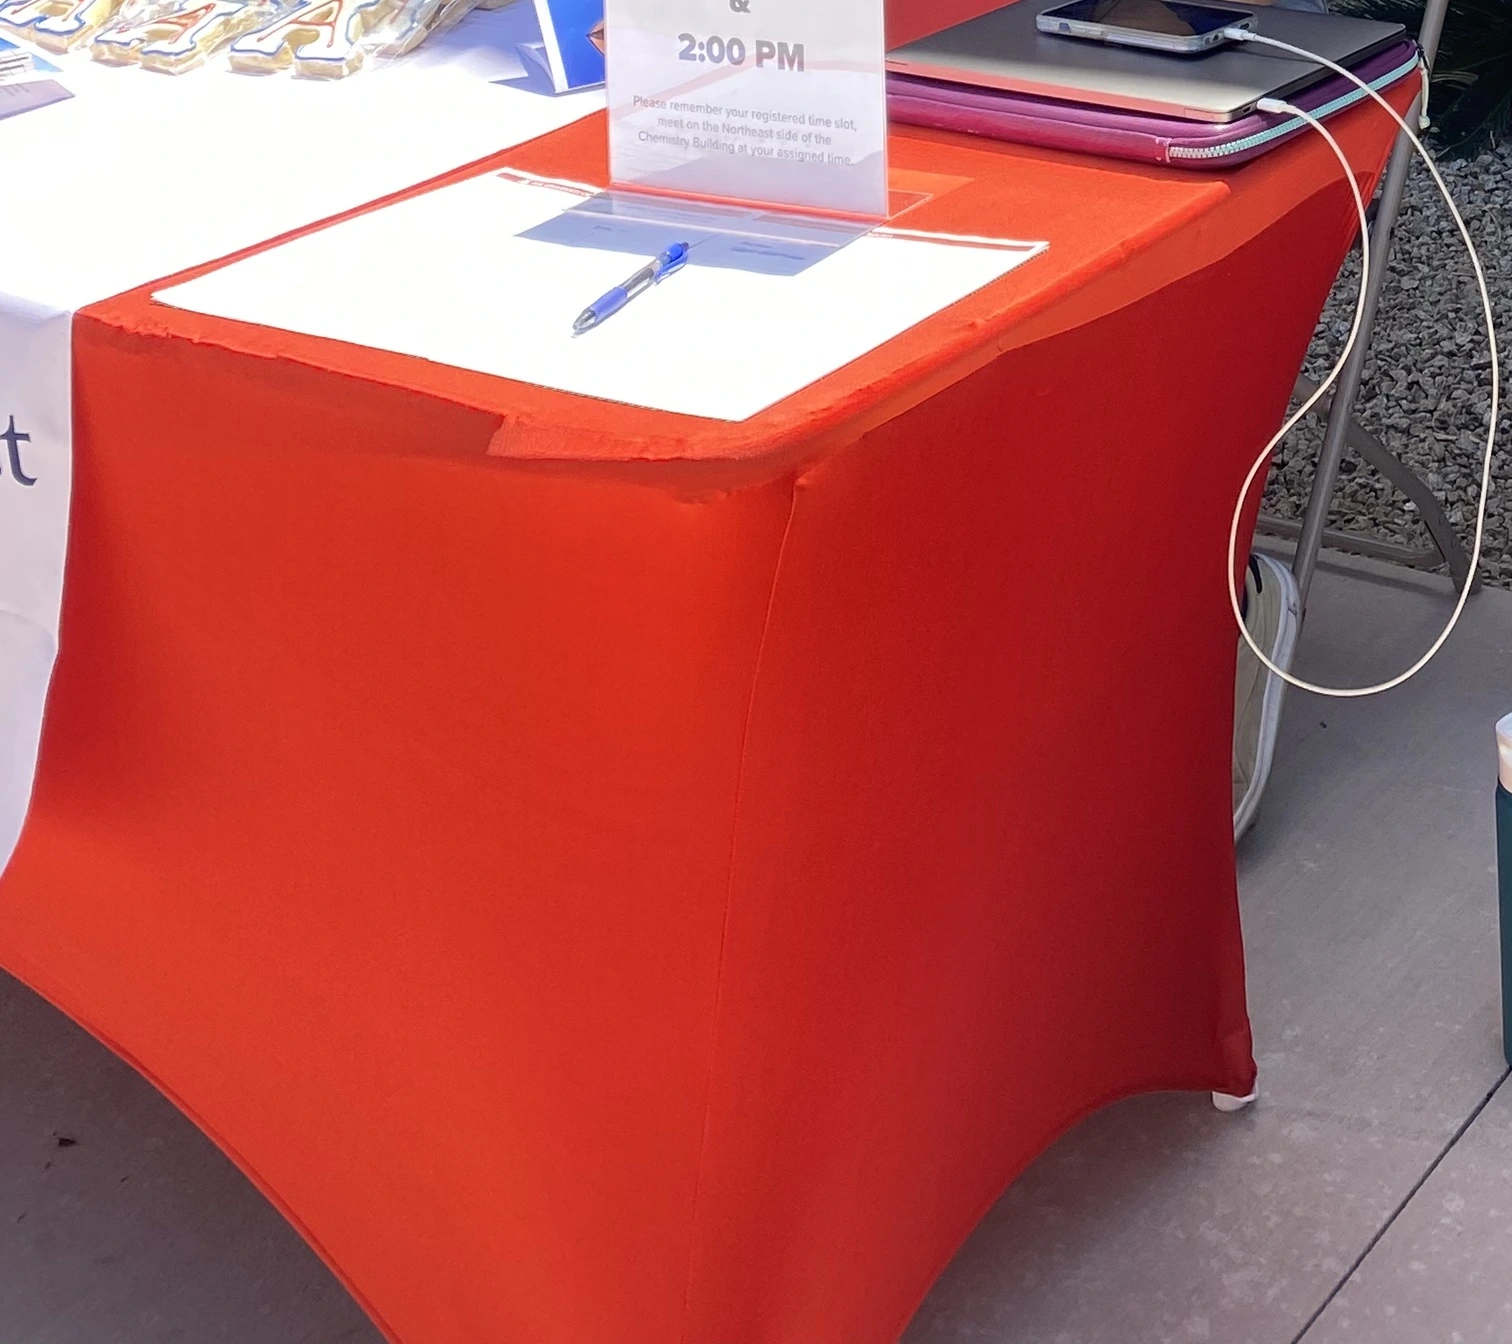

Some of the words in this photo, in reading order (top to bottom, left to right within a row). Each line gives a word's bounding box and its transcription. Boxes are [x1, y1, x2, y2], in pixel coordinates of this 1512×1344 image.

[677, 33, 746, 66] 2:00
[755, 40, 806, 73] PM
[632, 95, 667, 110] Please
[669, 101, 724, 116] remember
[725, 107, 750, 120] your
[751, 109, 806, 125] registered
[808, 114, 832, 128] time
[834, 117, 858, 132] slot,
[657, 116, 684, 130] meet
[686, 120, 701, 131] on
[702, 120, 720, 133] the
[721, 123, 774, 140] Northeast
[776, 128, 799, 142] side
[801, 130, 814, 143] of
[815, 132, 832, 146] the
[637, 130, 690, 150] Chemistry
[692, 136, 735, 155] Building
[737, 142, 748, 154] at
[750, 144, 775, 158] your
[777, 146, 825, 164] assigned
[827, 152, 855, 167] time.
